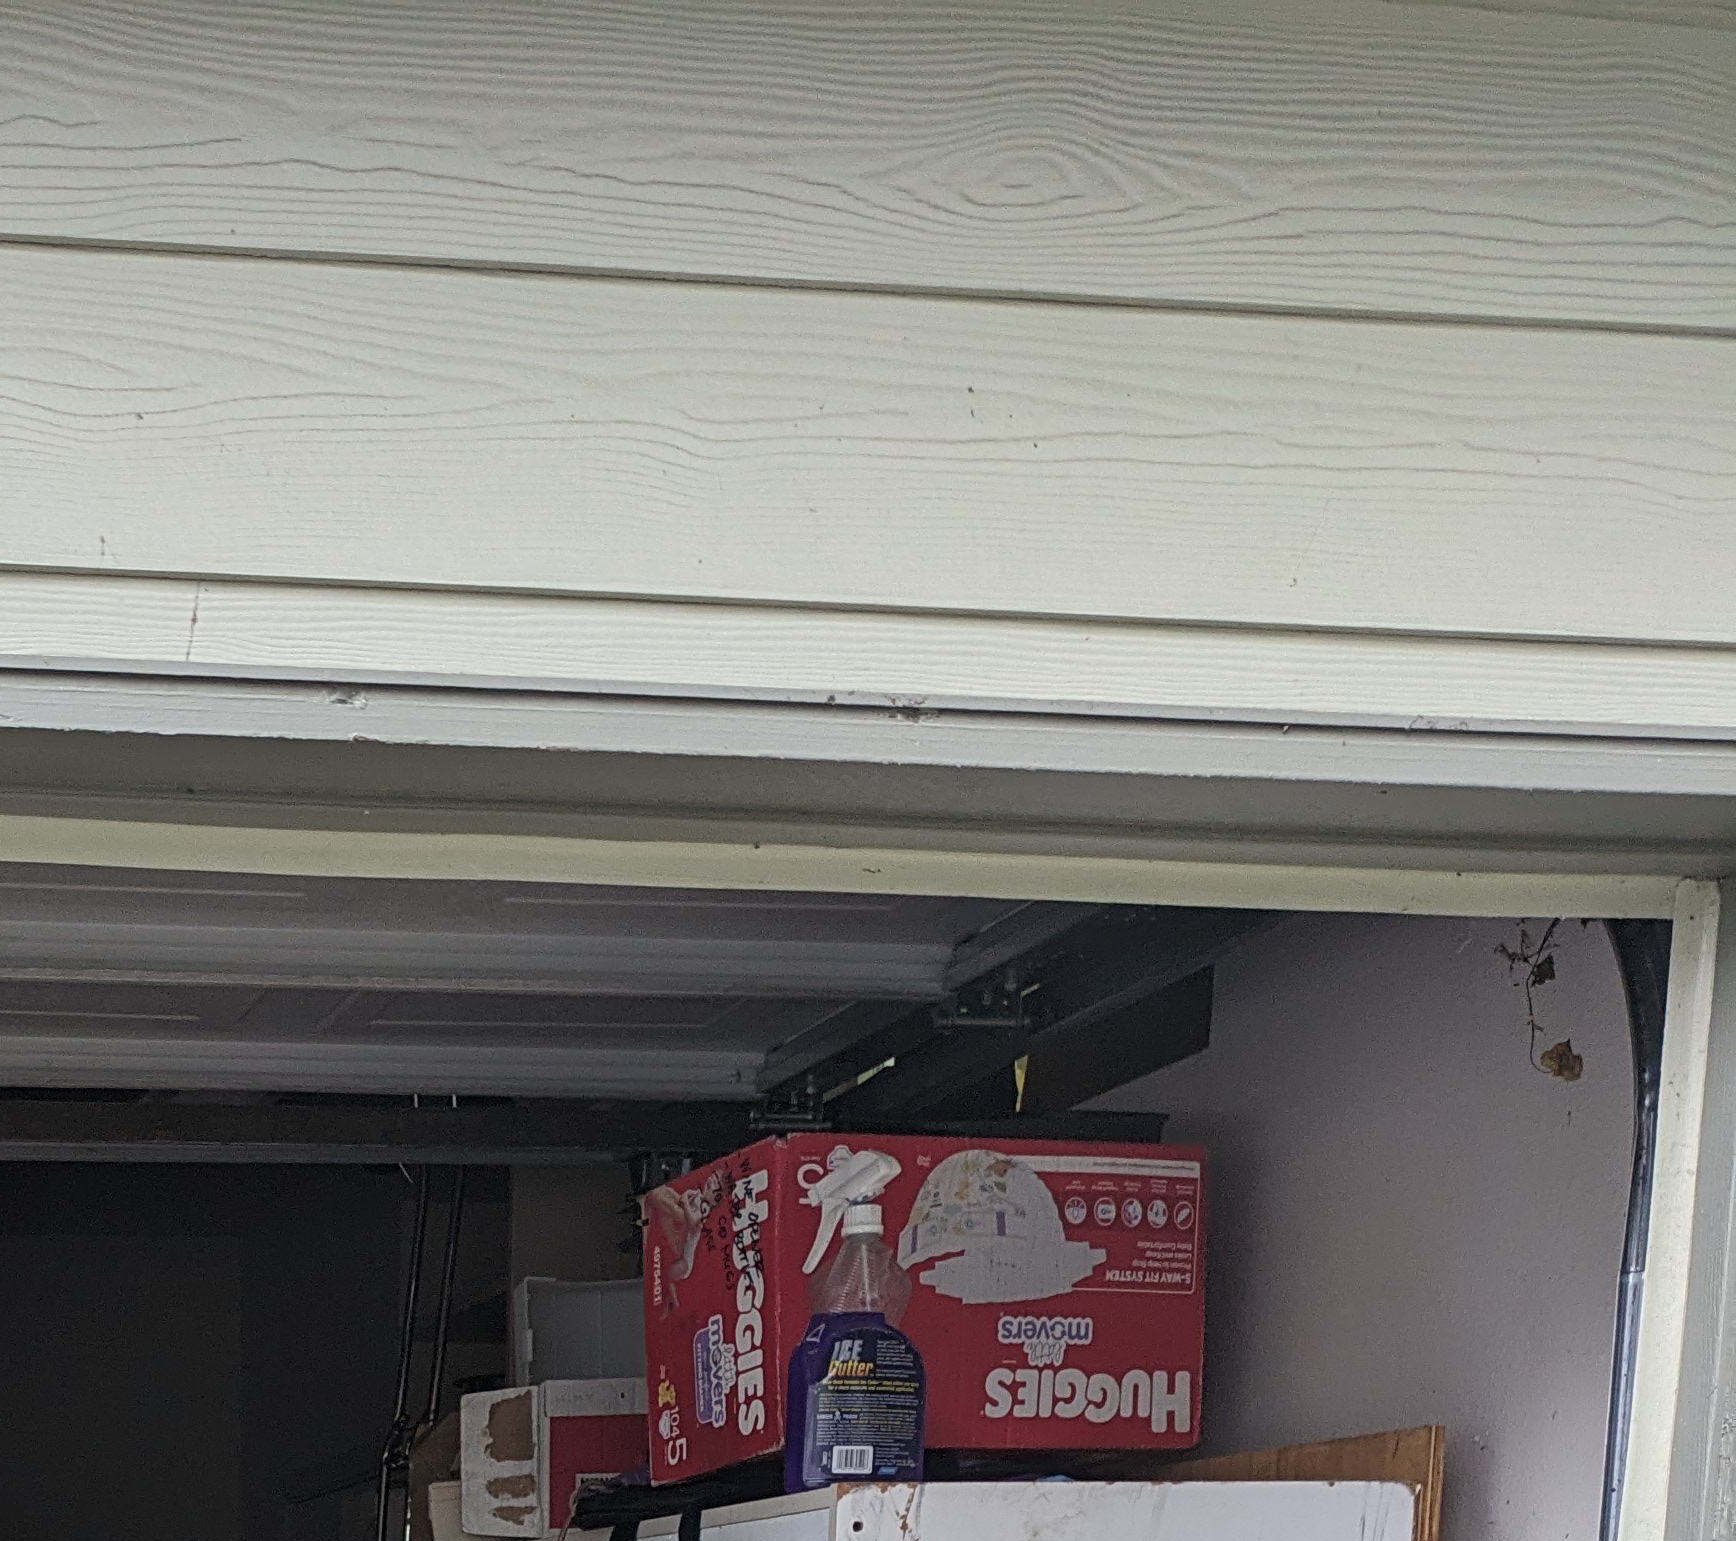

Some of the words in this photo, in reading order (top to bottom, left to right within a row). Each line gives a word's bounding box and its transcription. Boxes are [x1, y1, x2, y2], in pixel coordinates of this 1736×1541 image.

[1105, 1269, 1144, 1283] SYSTEM
[1145, 1270, 1160, 1283] FIT
[1159, 1271, 1192, 1285] 5-WAY
[731, 1168, 769, 1436] HUGGIES
[1000, 1319, 1091, 1342] movers
[830, 1339, 864, 1361] ICE
[710, 1316, 725, 1425] movers
[828, 1360, 874, 1377] Cutter
[984, 1367, 1192, 1434] HUGGIES
[668, 1405, 681, 1438] 104
[668, 1437, 687, 1466] 5
